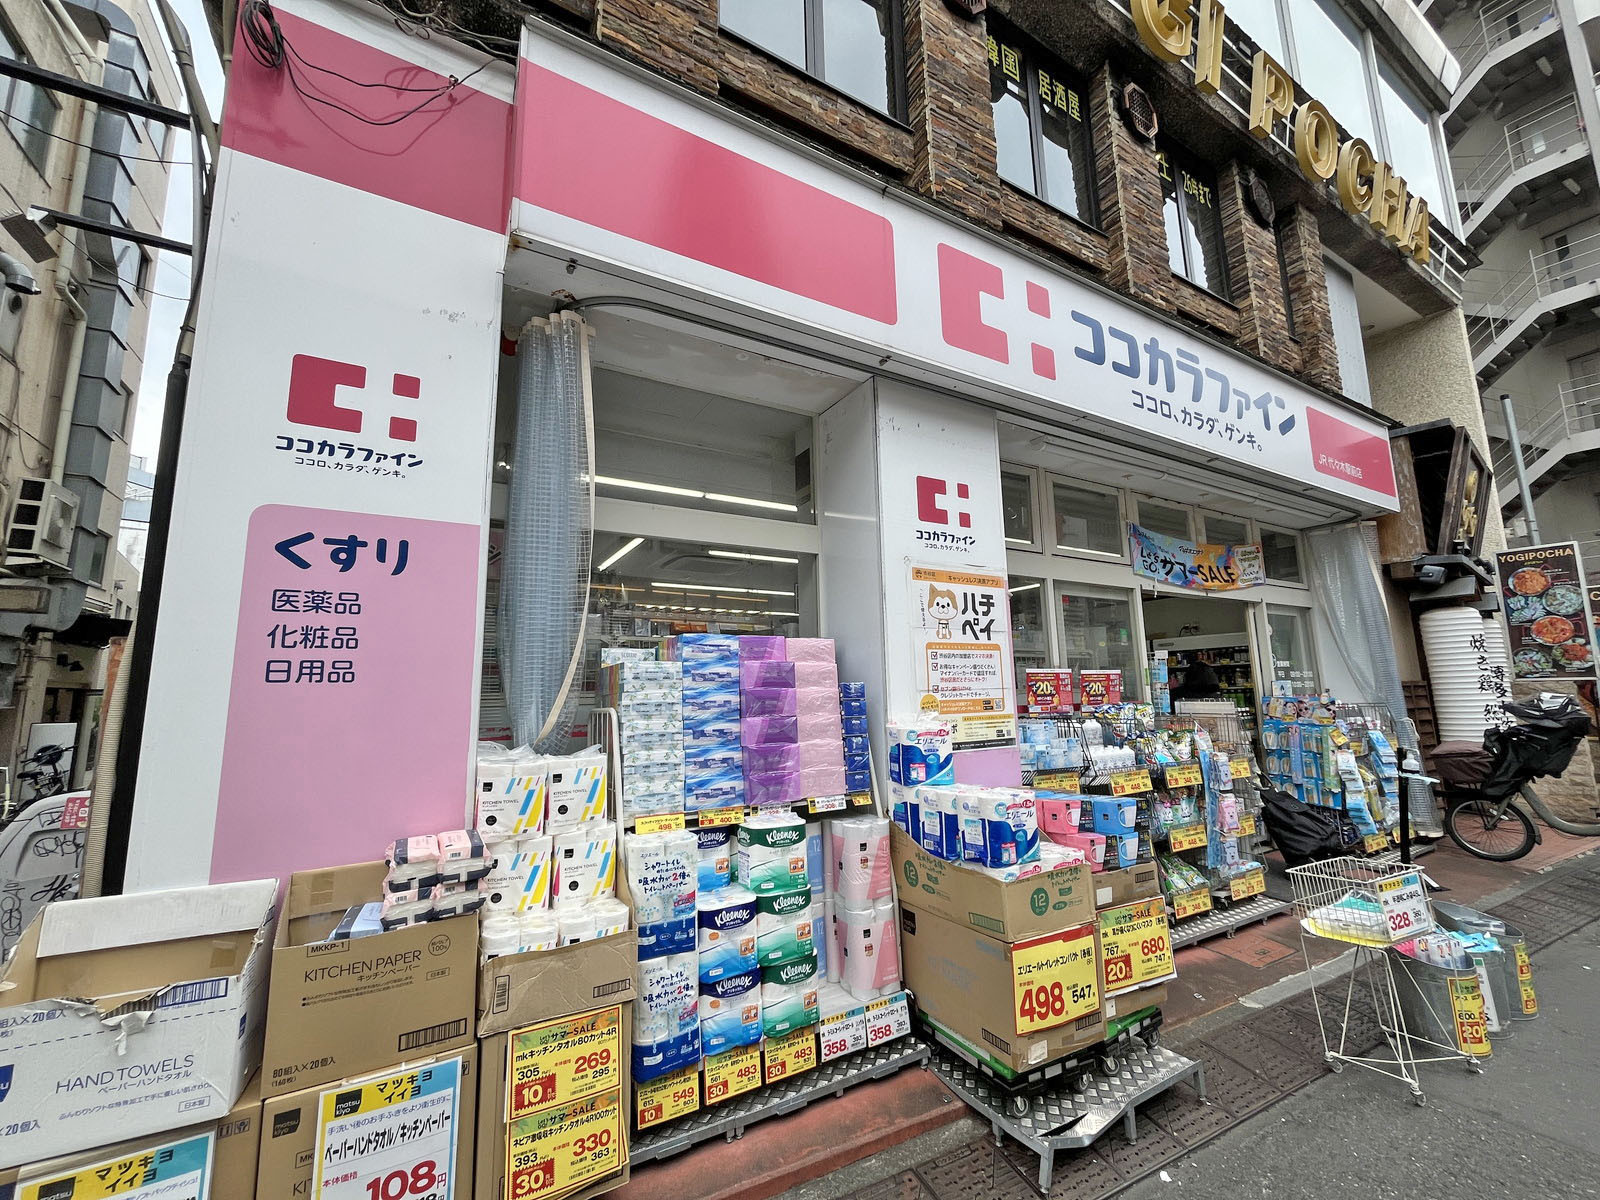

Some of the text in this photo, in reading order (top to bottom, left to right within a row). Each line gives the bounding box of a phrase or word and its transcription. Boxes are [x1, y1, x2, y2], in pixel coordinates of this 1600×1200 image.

[1038, 69, 1082, 122] 居酒屋
[1249, 49, 1430, 266] POCHA
[1070, 309, 1297, 437] ココカラファイン
[1131, 389, 1263, 452] ココロ、カラダ、ゲンキ。
[274, 435, 424, 468] ココカラファイン
[294, 456, 407, 479] ココロ、カラダ、ゲンキ。
[915, 529, 976, 546] ココカラファイン
[274, 531, 410, 576] くすり
[1498, 548, 1574, 563] YOGIPOCHA
[271, 588, 362, 615] 医薬品
[961, 592, 995, 617] ハチ
[266, 624, 359, 650] 化粧品
[961, 617, 996, 641] ペイ
[264, 659, 356, 684] 日用品
[915, 738, 947, 746] エリエール
[1005, 809, 1034, 820] エリエール
[766, 830, 800, 845] Kleenex
[644, 859, 681, 871] シャワートイレ
[906, 865, 917, 879] 12
[638, 871, 691, 887] 吸水力が2倍の
[644, 881, 688, 894] トイレットペーパー
[773, 894, 807, 912] Kleenex
[1033, 893, 1047, 908] 12
[715, 908, 751, 927] Kleenex
[1389, 911, 1411, 932] 328
[310, 941, 346, 953] MKKP-1
[1105, 945, 1120, 957] 767
[1141, 935, 1165, 957] 680
[304, 949, 422, 983] KITCHEN PAPER
[356, 964, 421, 982] キッチンペーパー
[780, 961, 813, 982] Kleenex
[1017, 952, 1079, 976] エリエールトイレットコンパクト
[1108, 961, 1126, 982] 20
[649, 971, 685, 987] シャワートイレ
[715, 974, 753, 996] Kleenex
[649, 993, 692, 1012] トイレットペーパー
[1019, 981, 1065, 1023] 498
[1072, 984, 1092, 1004] 547
[550, 1022, 597, 1041] サマーSALE
[869, 1024, 892, 1042] 358
[1462, 1026, 1481, 1039] 20
[793, 1046, 813, 1060] 483
[823, 1038, 847, 1057] 358
[272, 1056, 336, 1078] 80組入×20個入
[574, 1048, 611, 1075] 269
[736, 1064, 757, 1078] 483
[769, 1065, 782, 1077] 30
[55, 1054, 195, 1094] HAND TOWELS
[97, 1069, 192, 1095] ペーパーハンドタオル
[376, 1070, 433, 1094] マツキヨ
[517, 1066, 540, 1081] 305
[591, 1066, 610, 1080] 295
[384, 1084, 422, 1103] イイヨ
[521, 1084, 543, 1106] 10
[672, 1086, 695, 1103] 549
[709, 1085, 724, 1098] 30
[184, 1099, 206, 1110] 日本製
[335, 1107, 351, 1116] kiyo
[336, 1099, 361, 1112] matsu
[549, 1102, 596, 1125] サマーSALE
[327, 1095, 451, 1136] 手洗い後のお手ふきをより衛生的に
[643, 1109, 656, 1122] 10
[572, 1128, 612, 1157] 330
[514, 1152, 538, 1169] 393
[590, 1147, 610, 1162] 363
[96, 1149, 175, 1182] マツキヨ
[104, 1168, 158, 1193] イイヨ
[322, 1171, 358, 1187] 本体価格
[366, 1160, 437, 1200] 108
[437, 1172, 447, 1189] 円
[515, 1169, 545, 1195] 30
